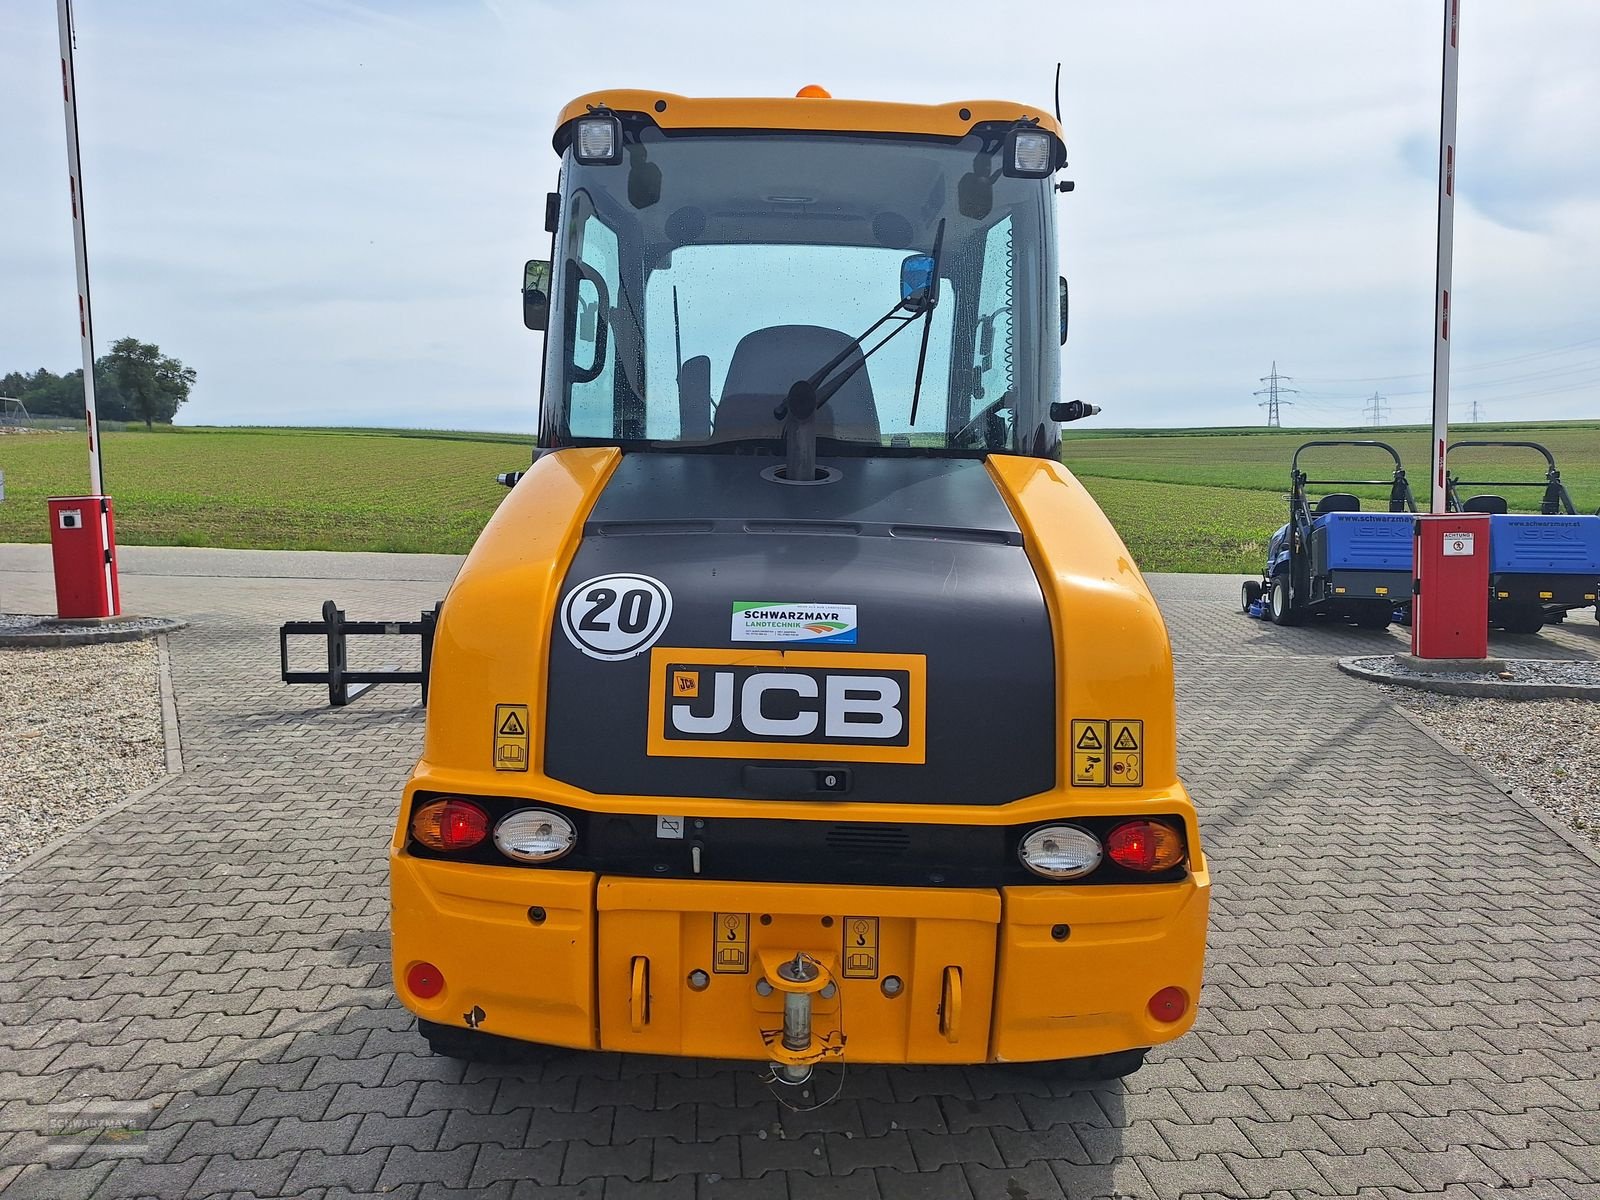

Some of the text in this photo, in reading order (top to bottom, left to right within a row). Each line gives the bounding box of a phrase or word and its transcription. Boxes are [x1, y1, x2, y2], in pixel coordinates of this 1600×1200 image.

[1518, 530, 1581, 540] ISEKI
[579, 588, 653, 634] 20
[744, 611, 839, 621] SCHWARZMAYR
[680, 678, 696, 690] JCB
[672, 672, 903, 739] JCB
